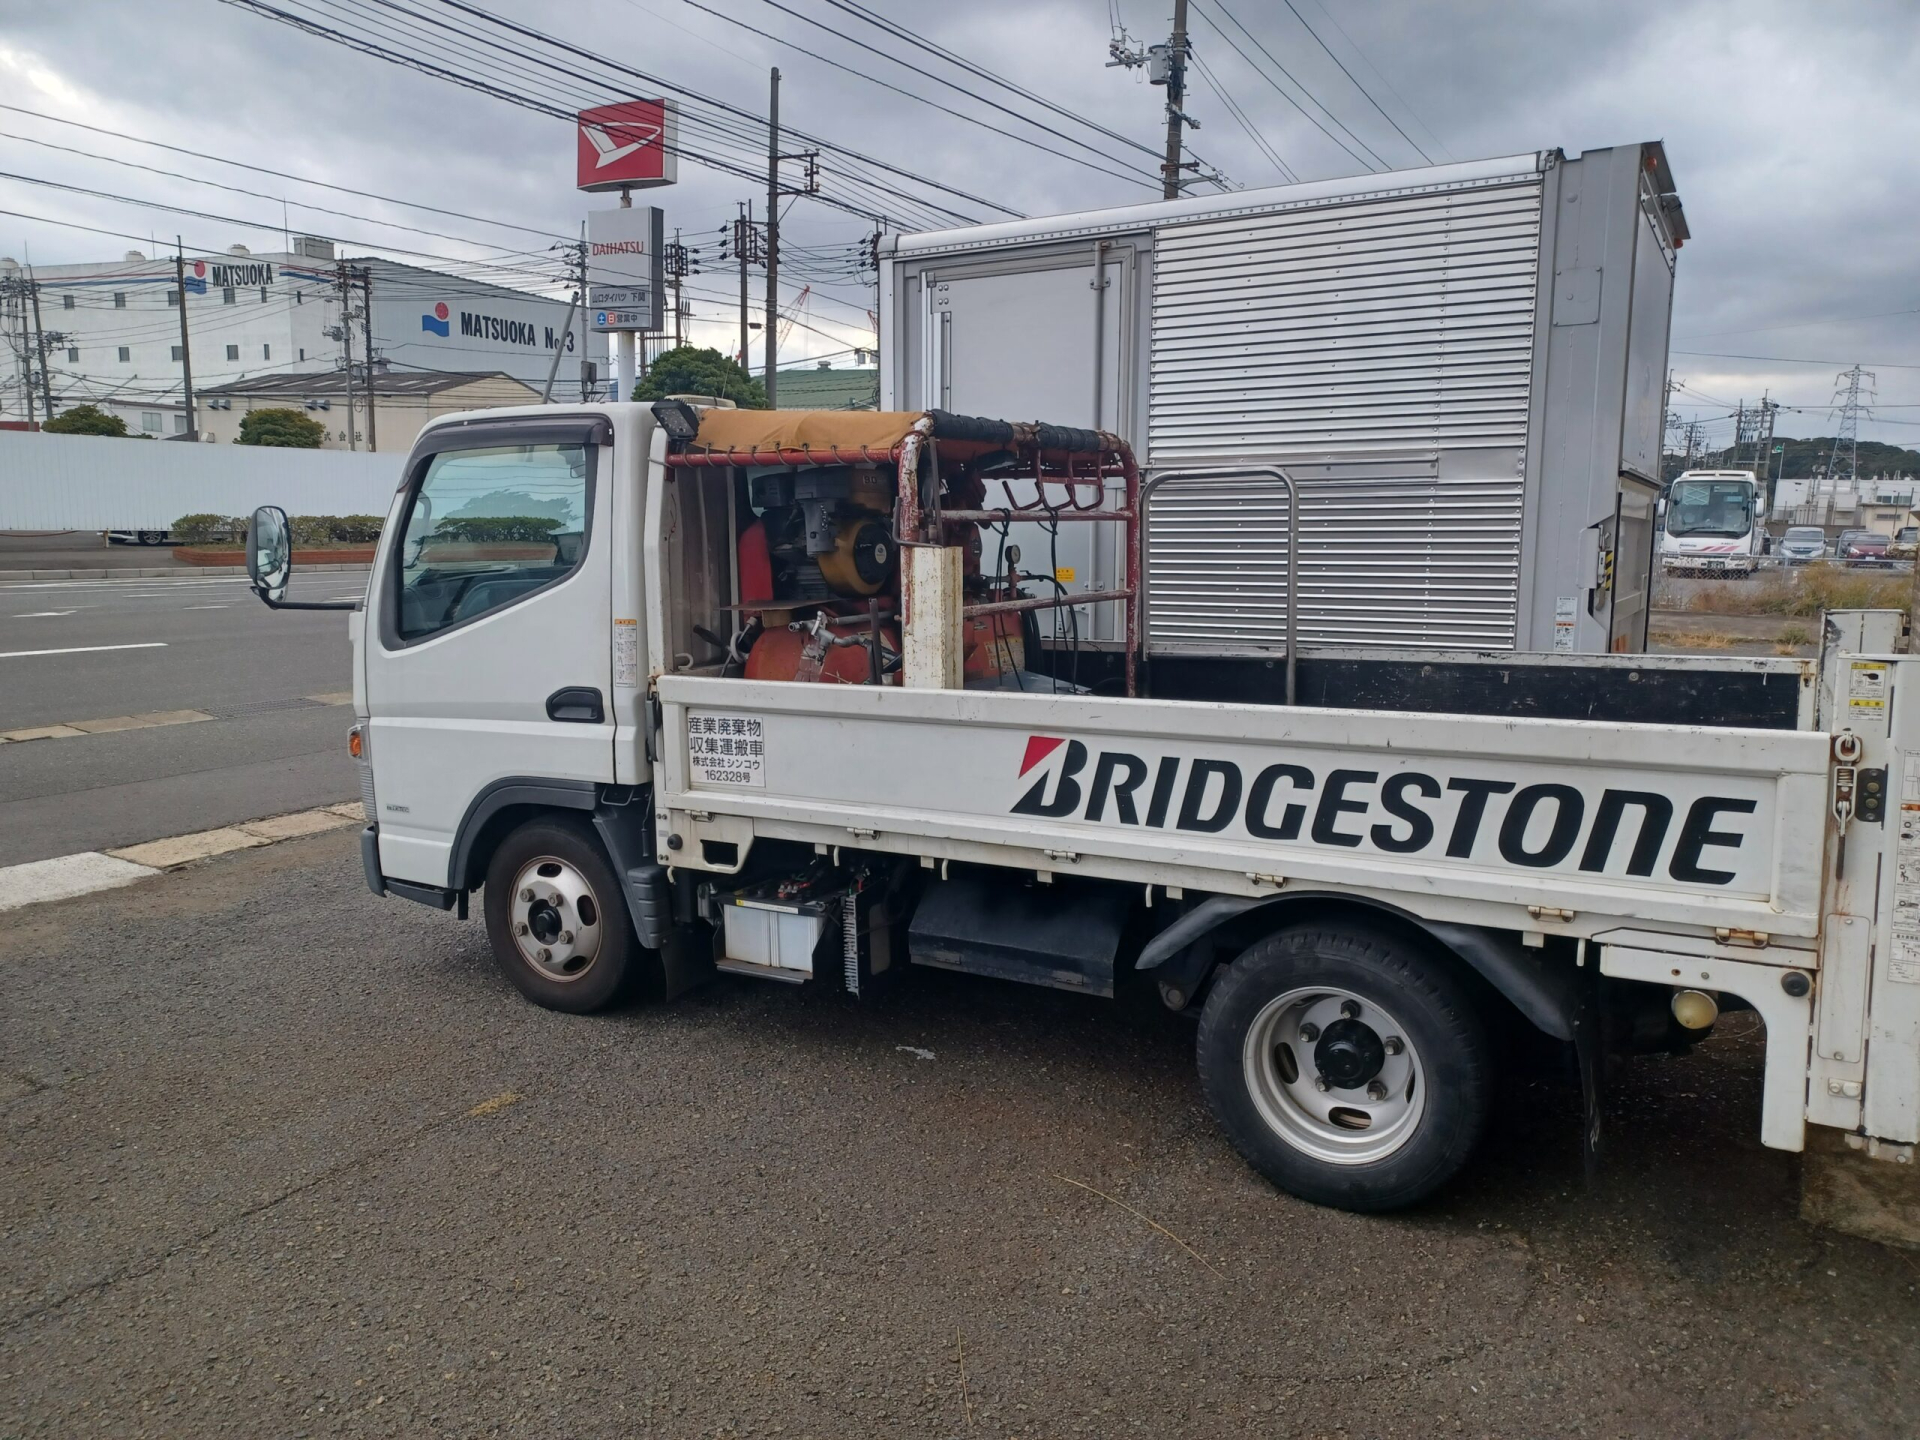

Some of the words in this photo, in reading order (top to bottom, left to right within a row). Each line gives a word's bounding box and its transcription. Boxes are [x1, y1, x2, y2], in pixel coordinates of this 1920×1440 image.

[592, 241, 644, 256] DAIHATSU
[212, 263, 273, 287] MATSUOKA
[630, 292, 646, 302] 下関
[460, 311, 536, 347] MATSUOKA
[688, 716, 761, 737] 産業廃棄物
[689, 736, 764, 757] 収集運搬車
[692, 756, 726, 768] 株式会社
[705, 769, 751, 783] 162328号
[1010, 735, 1757, 885] BRIDGESTONE
